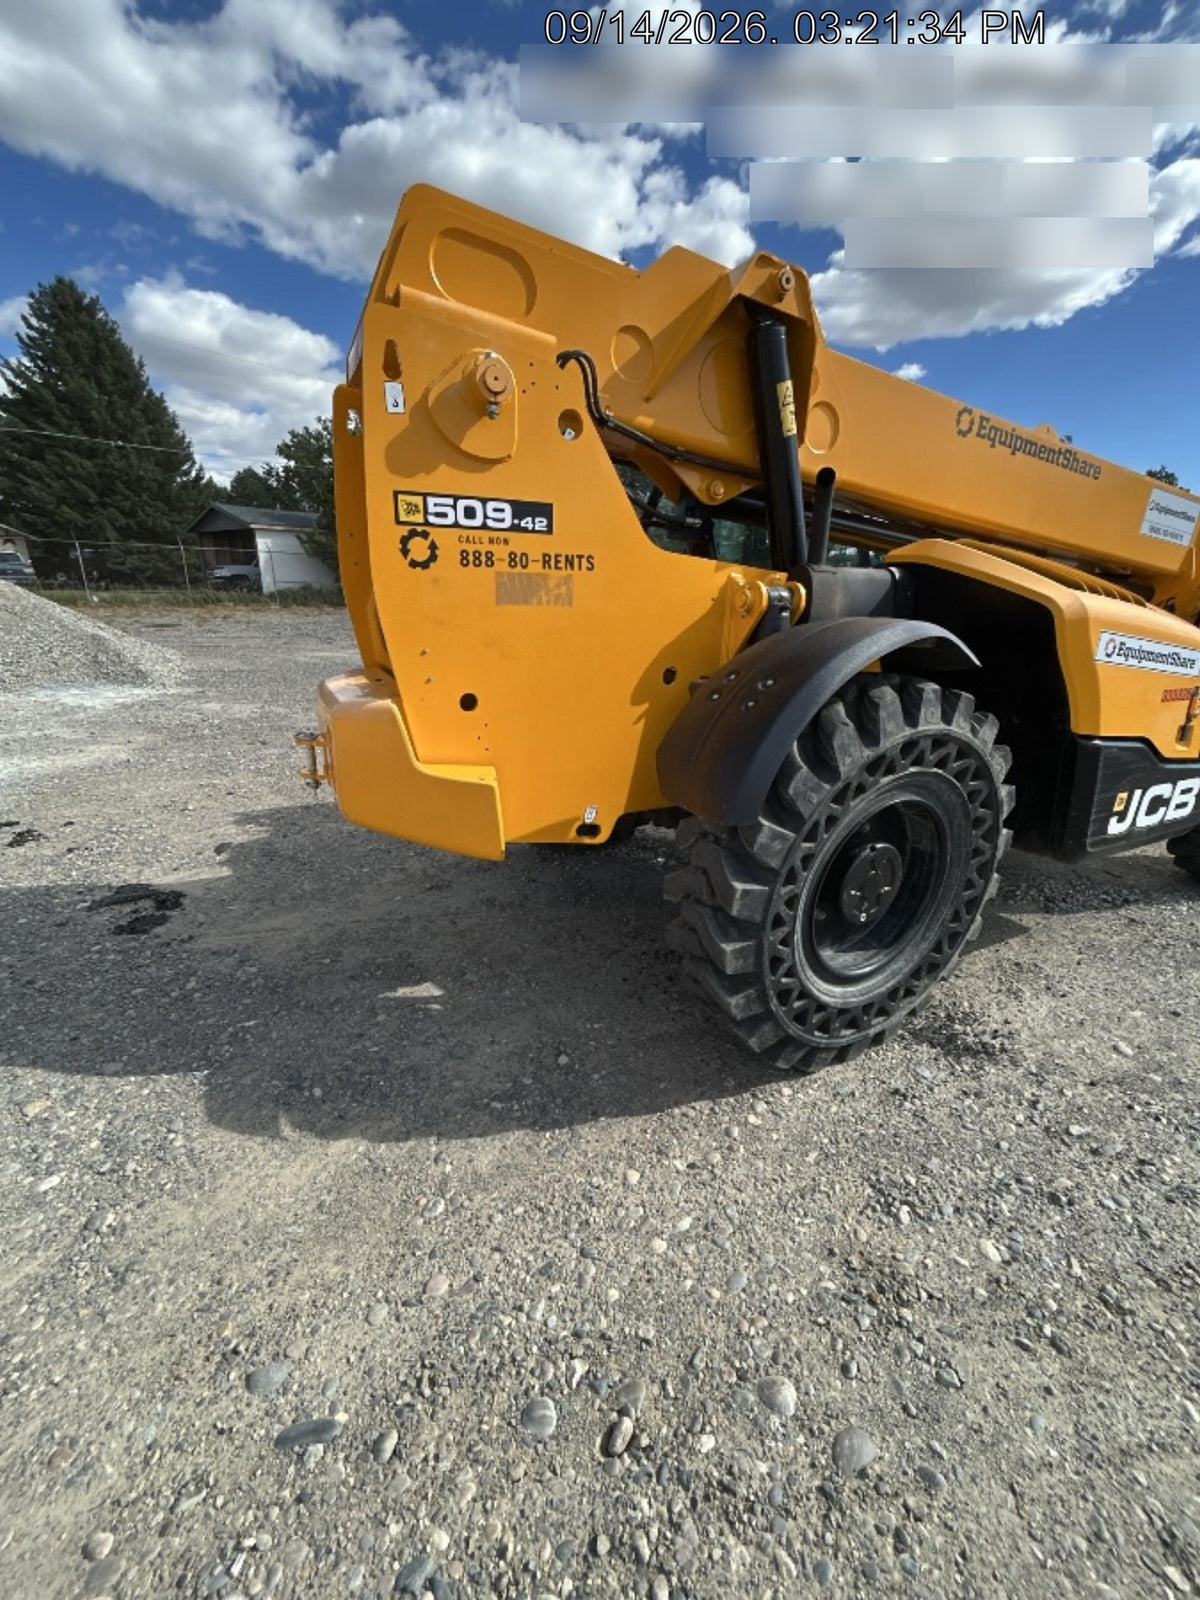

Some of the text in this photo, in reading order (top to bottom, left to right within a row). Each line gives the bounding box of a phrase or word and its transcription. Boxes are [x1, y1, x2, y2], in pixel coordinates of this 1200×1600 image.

[976, 415, 1102, 480] EquipmentShare
[458, 534, 510, 546] CALL NOW
[459, 549, 595, 571] 888-80-RENTS
[1116, 641, 1196, 669] EquipmentShare
[1107, 777, 1200, 834] JCB
